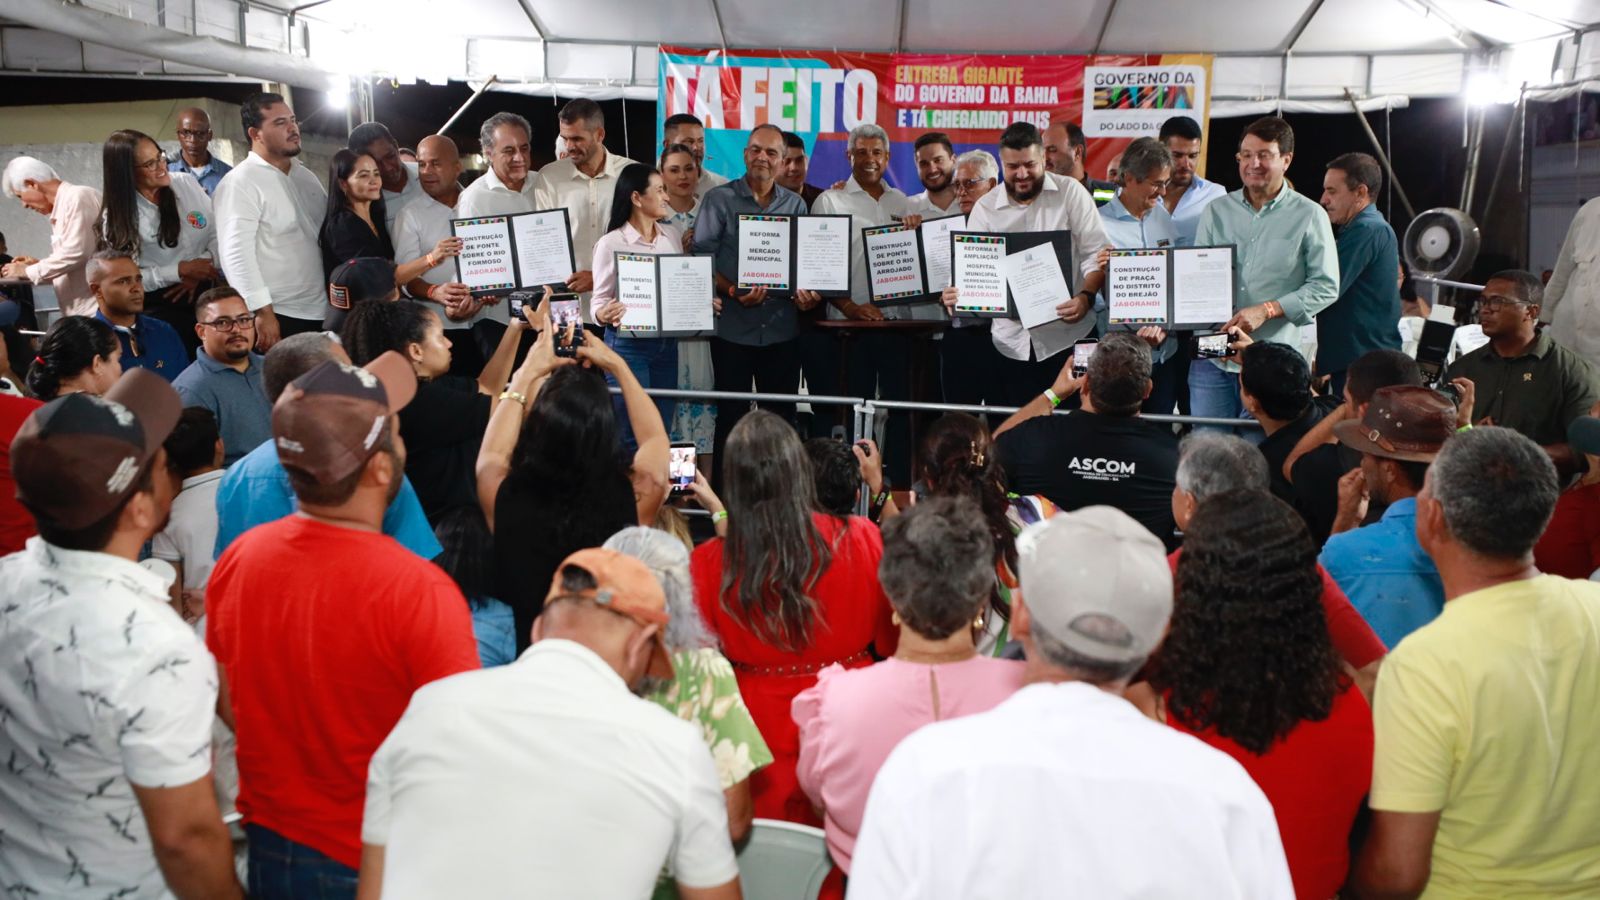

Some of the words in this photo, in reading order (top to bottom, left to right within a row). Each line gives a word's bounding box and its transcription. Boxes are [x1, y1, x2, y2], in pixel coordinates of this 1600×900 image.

[896, 65, 958, 84] ENTREGA
[963, 66, 1024, 84] GIGANTE
[1094, 72, 1170, 86] GOVERNO
[1175, 72, 1195, 84] DA
[666, 50, 725, 128] TÁ
[740, 67, 878, 133] FEITO
[895, 84, 914, 102] DO
[919, 85, 985, 103] GOVERNO
[990, 86, 1009, 104] DA
[1014, 86, 1058, 104] BAHIA
[898, 109, 906, 127] E
[912, 105, 928, 128] TÁ
[932, 110, 1008, 129] CHEGANDO
[1100, 122, 1114, 130] DO
[1116, 122, 1140, 130] LADO
[1142, 122, 1154, 130] DA
[871, 242, 912, 250] CONSTRUÇÃO
[468, 258, 502, 266] FORMOSO
[464, 266, 507, 276] JABORANDI
[876, 266, 912, 275] ARROJADO
[876, 274, 915, 284] JABORANDI
[1068, 456, 1136, 474] ASCOM
